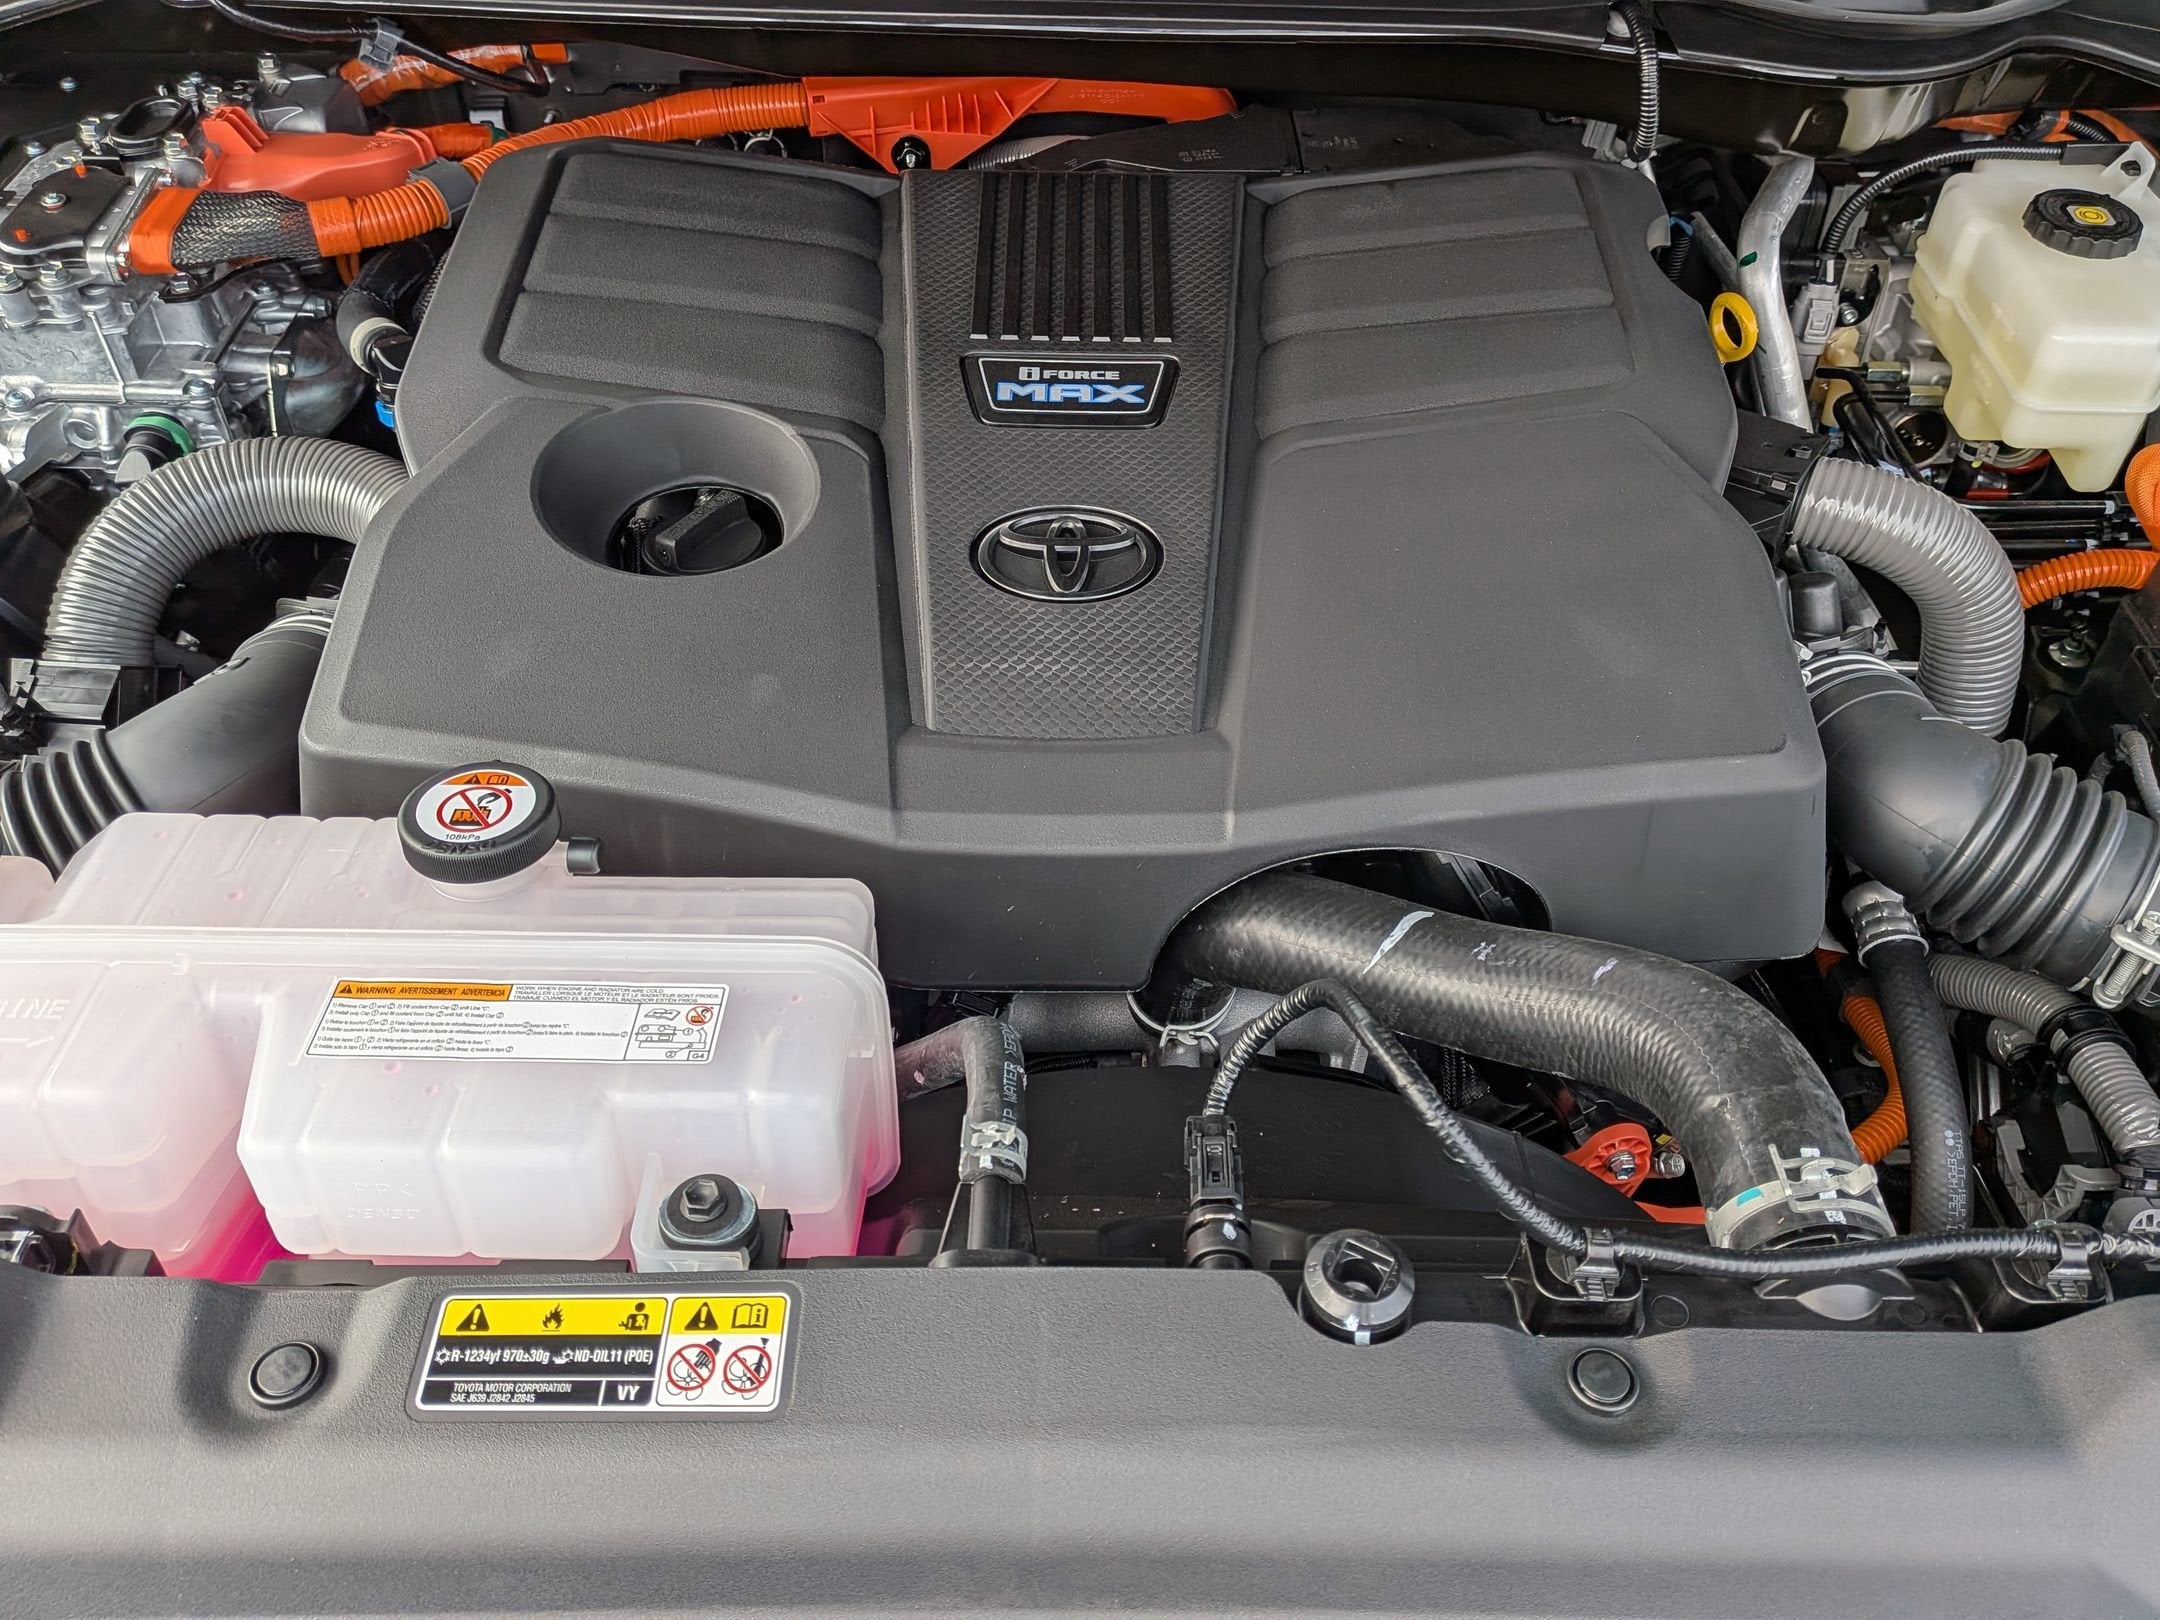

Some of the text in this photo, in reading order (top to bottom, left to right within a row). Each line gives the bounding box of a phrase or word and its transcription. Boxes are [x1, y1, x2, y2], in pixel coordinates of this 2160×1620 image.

[1043, 370, 1119, 380] FORCE
[996, 382, 1144, 403] MAX
[399, 987, 458, 995] AVERTISSEMENT
[1002, 1061, 1018, 1103] WATER
[1955, 1130, 1964, 1159] TTAS
[346, 1208, 421, 1220] DENSO
[451, 1349, 652, 1364] R-1234yf 970±30g ND-OIL11 (POE)
[454, 1382, 571, 1393] TOYOTA MOTOR CORPORATION
[617, 1384, 640, 1401] VY
[451, 1394, 535, 1403] SAE J639 J2842 J2845
